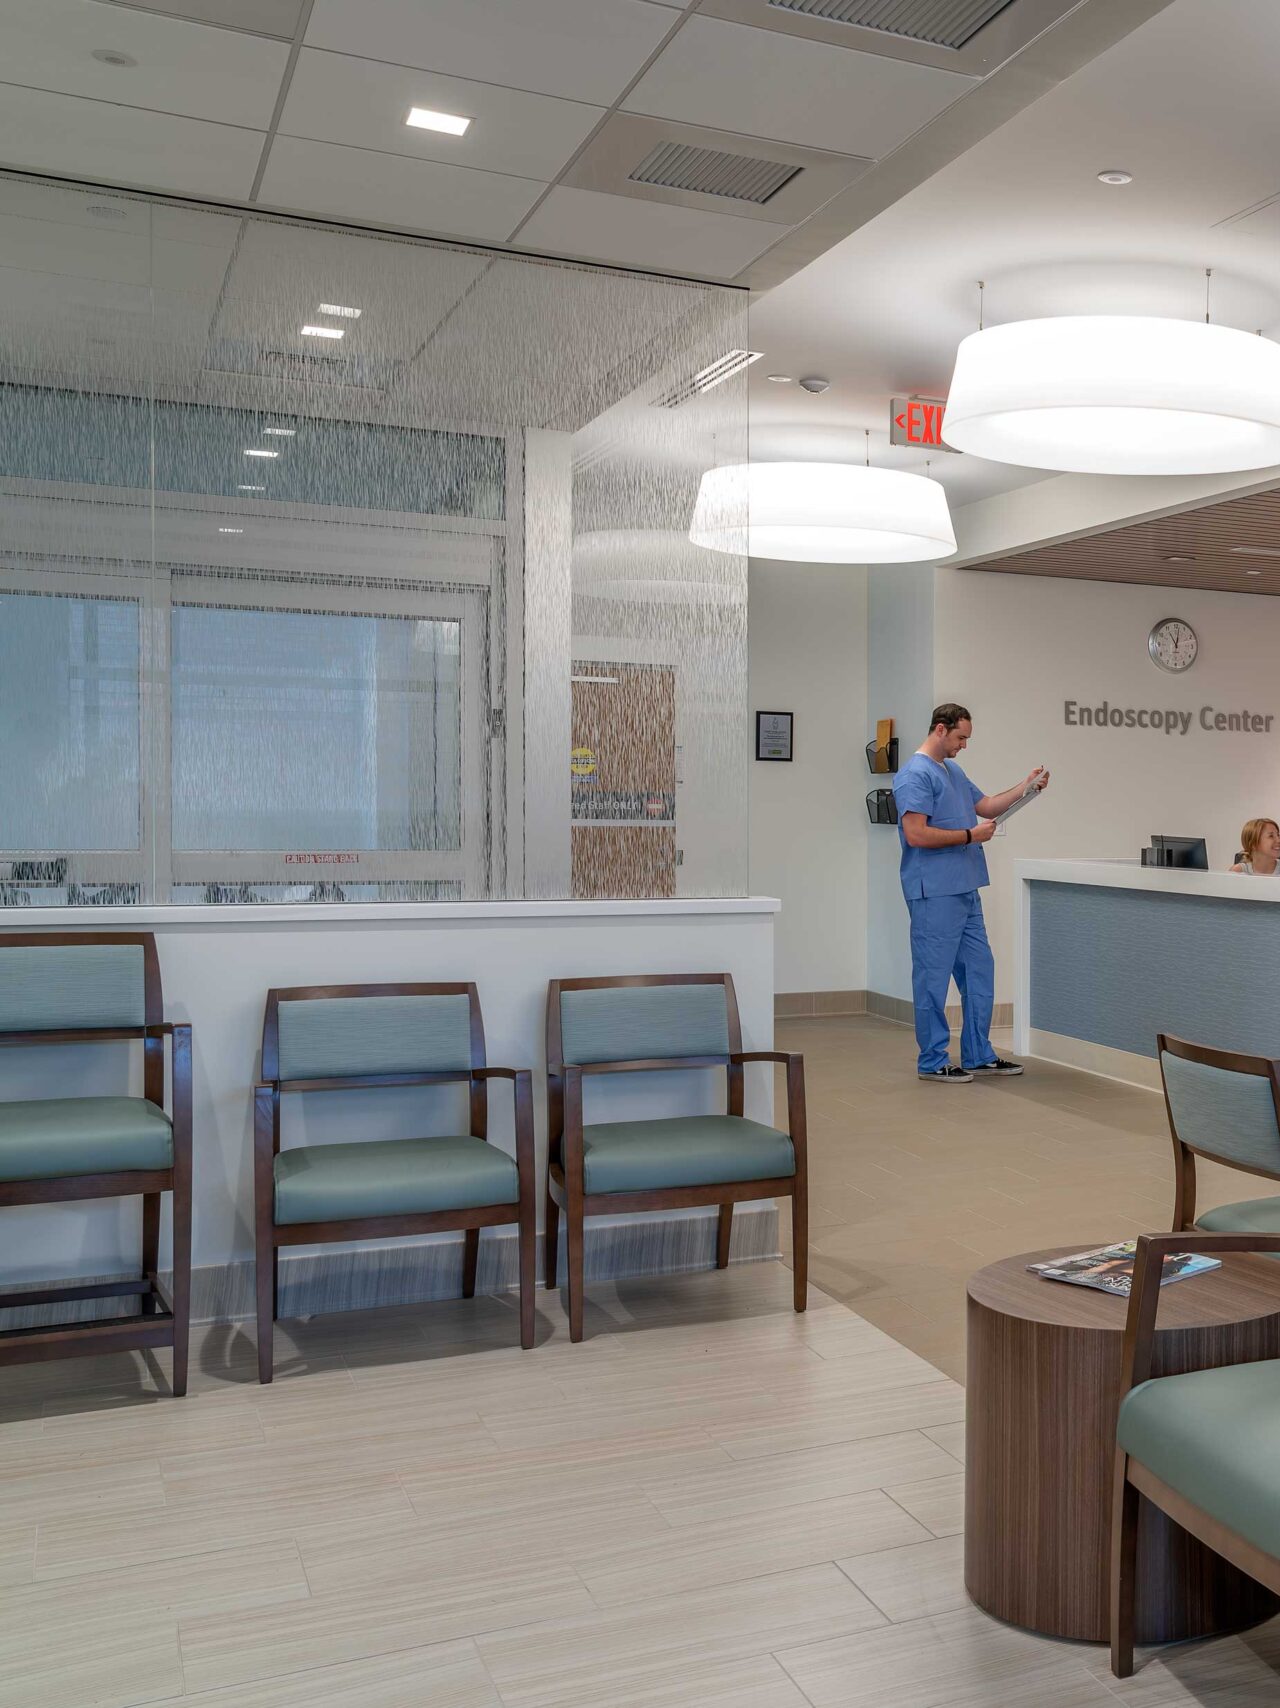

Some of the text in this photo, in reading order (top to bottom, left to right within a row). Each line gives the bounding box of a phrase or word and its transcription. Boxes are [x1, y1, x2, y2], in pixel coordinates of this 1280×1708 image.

[907, 402, 945, 445] EXI
[1064, 700, 1275, 736] Endoscopy Center
